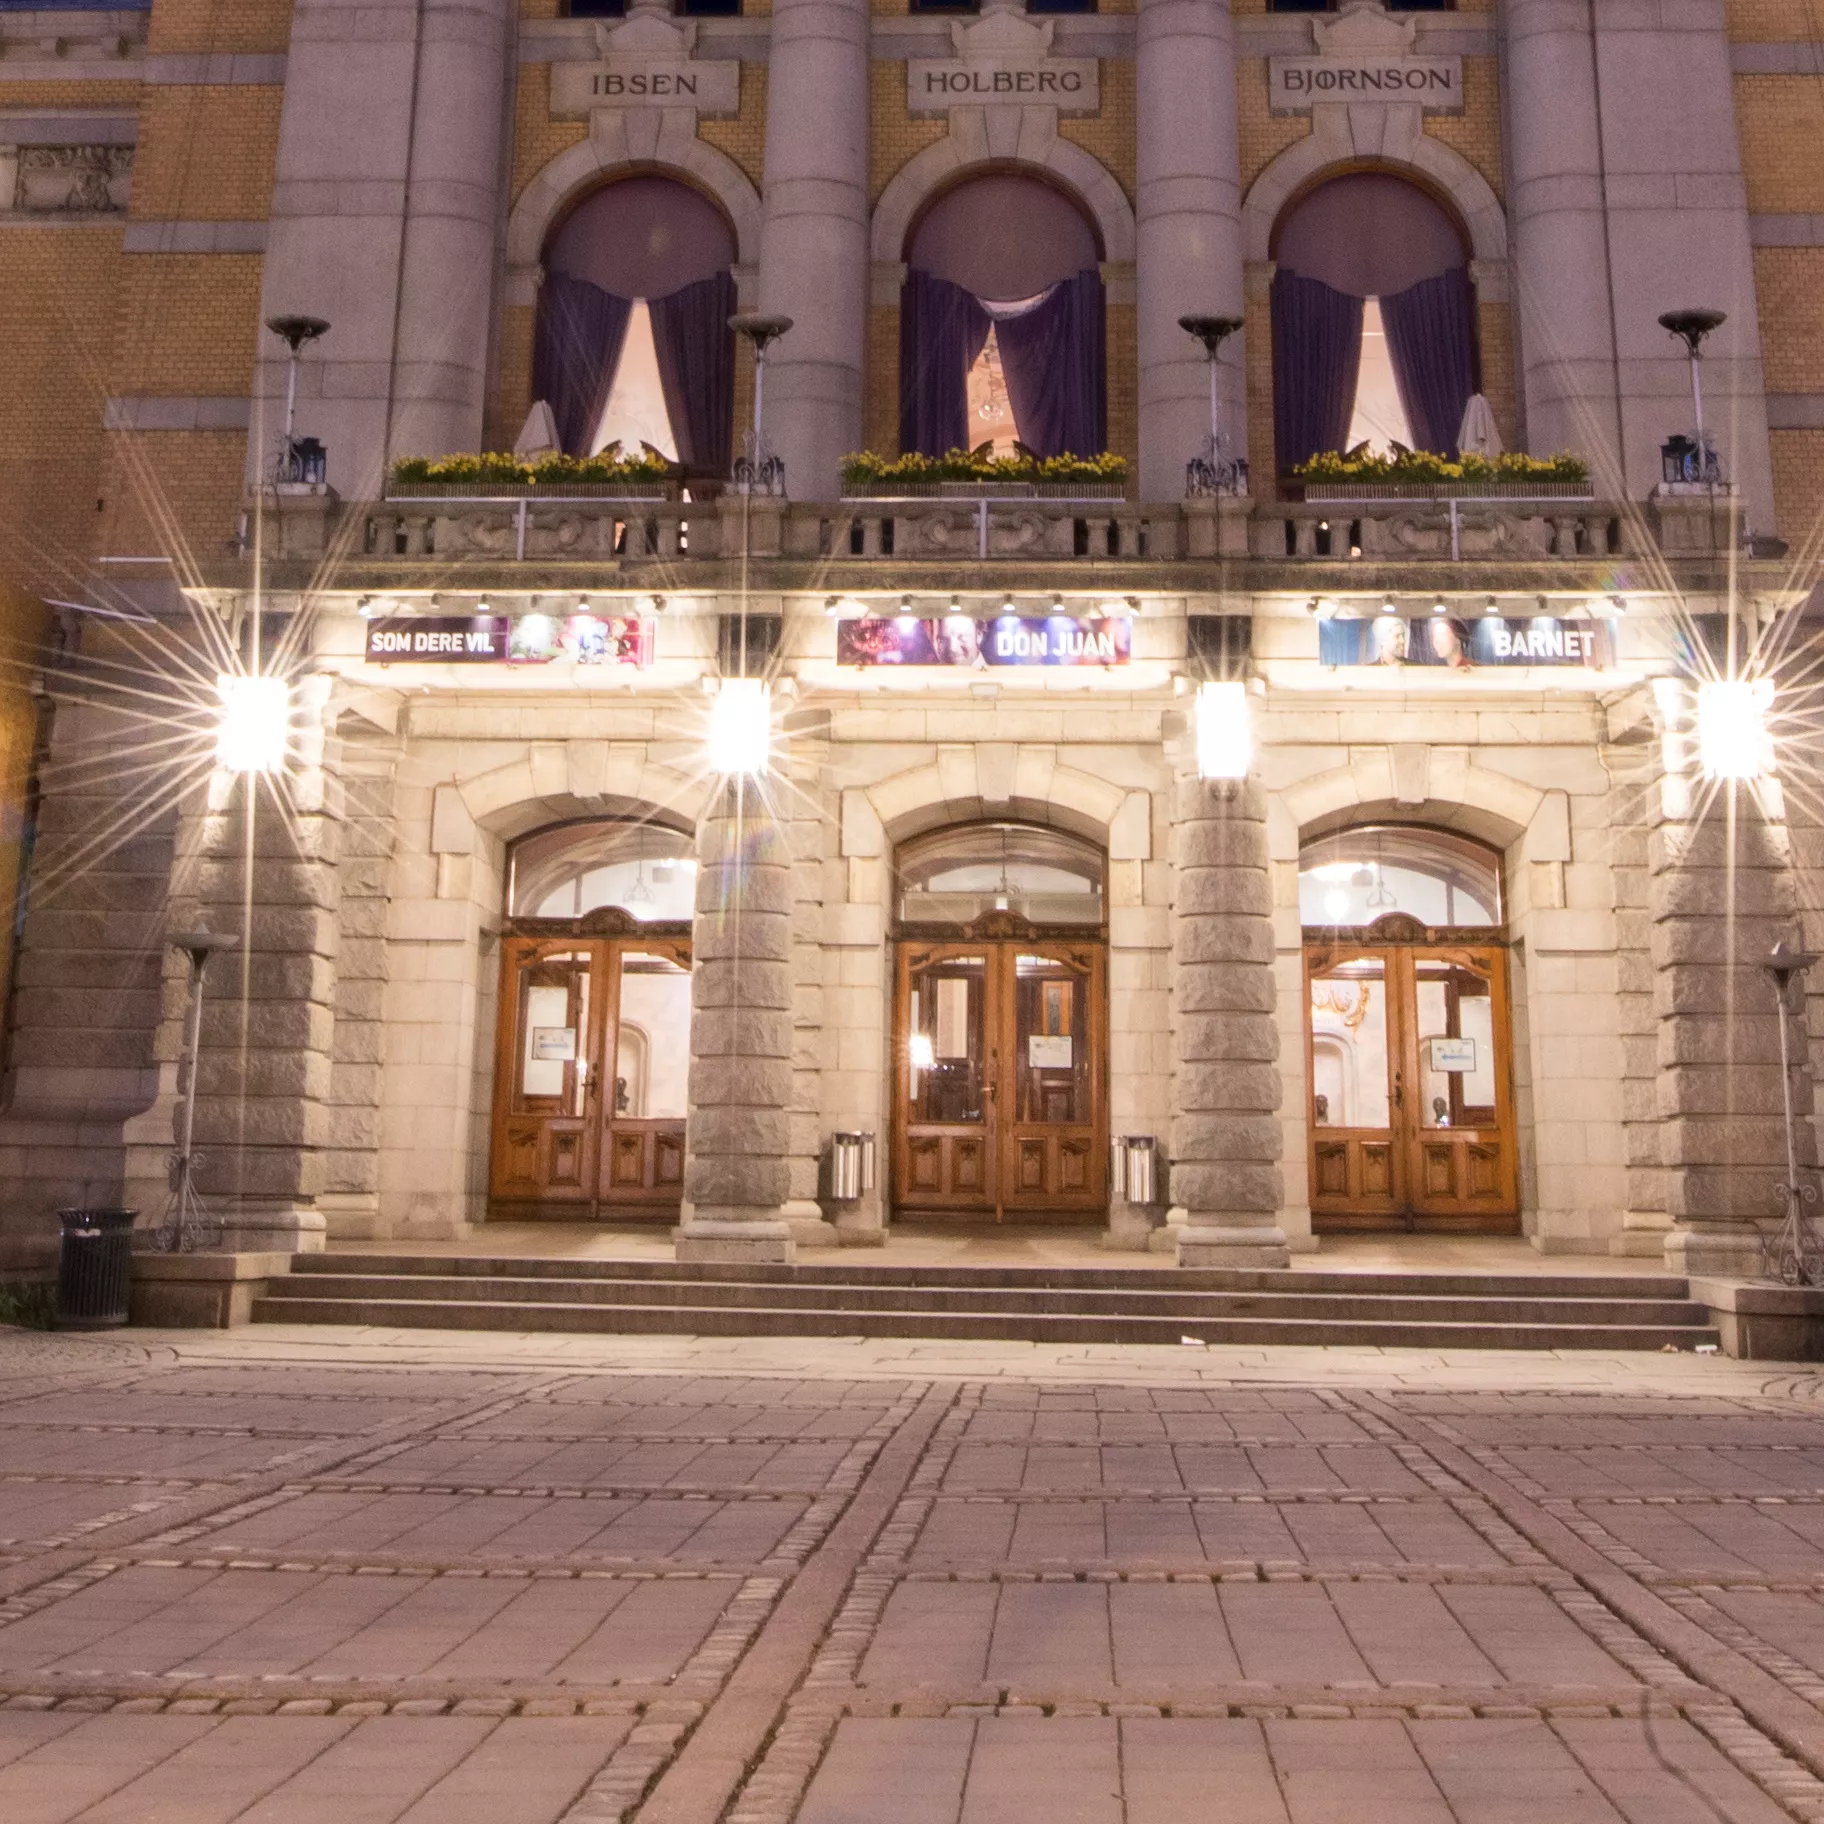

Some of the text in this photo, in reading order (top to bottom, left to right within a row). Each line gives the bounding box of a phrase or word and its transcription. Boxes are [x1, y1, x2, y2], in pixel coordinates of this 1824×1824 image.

[592, 72, 698, 96] IBSEN
[925, 70, 1083, 94] HOLBERG
[1283, 69, 1452, 94] BJØRNSON
[371, 632, 495, 653] SOM DERE VIL
[997, 631, 1115, 656] DON JUAN
[1494, 631, 1595, 657] BARNET
